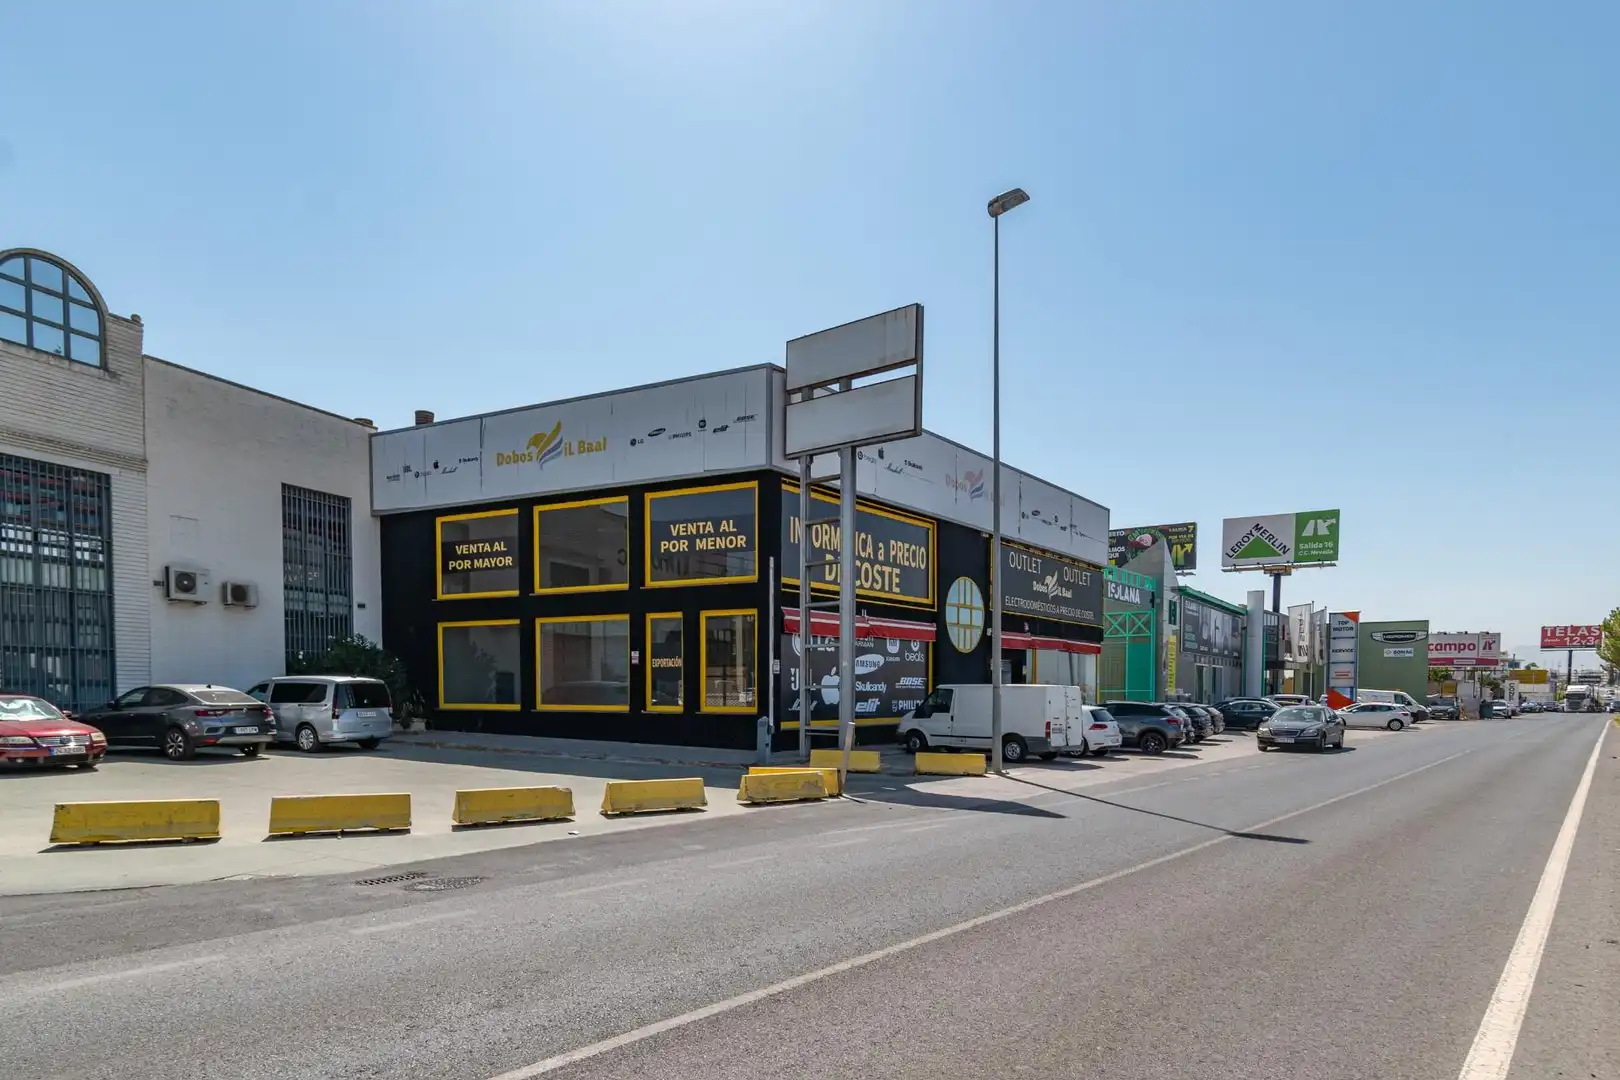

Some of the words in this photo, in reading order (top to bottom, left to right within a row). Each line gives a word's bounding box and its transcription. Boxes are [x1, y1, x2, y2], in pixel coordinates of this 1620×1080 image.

[496, 450, 533, 467] Dobos
[577, 435, 607, 455] Baal
[670, 521, 714, 537] VENTA
[719, 519, 737, 533] AL
[455, 543, 491, 555] VENTA
[493, 541, 508, 552] AL
[660, 539, 689, 553] POR
[695, 534, 747, 551] MENOR
[1225, 530, 1255, 559] LEROY
[1252, 523, 1291, 555] MERLIN
[1299, 541, 1323, 550] Salida
[878, 542, 885, 562] a
[890, 539, 927, 570] PRECIO
[448, 559, 471, 571] POR
[474, 556, 513, 569] MAYOR
[1009, 552, 1042, 575] OUTLET
[1063, 566, 1092, 587] OUTLET
[1544, 626, 1600, 637] TELAS
[855, 659, 881, 668] AMSUNG
[904, 650, 925, 663] beats
[855, 680, 887, 694] Skullcandy
[900, 677, 927, 686] BOSE
